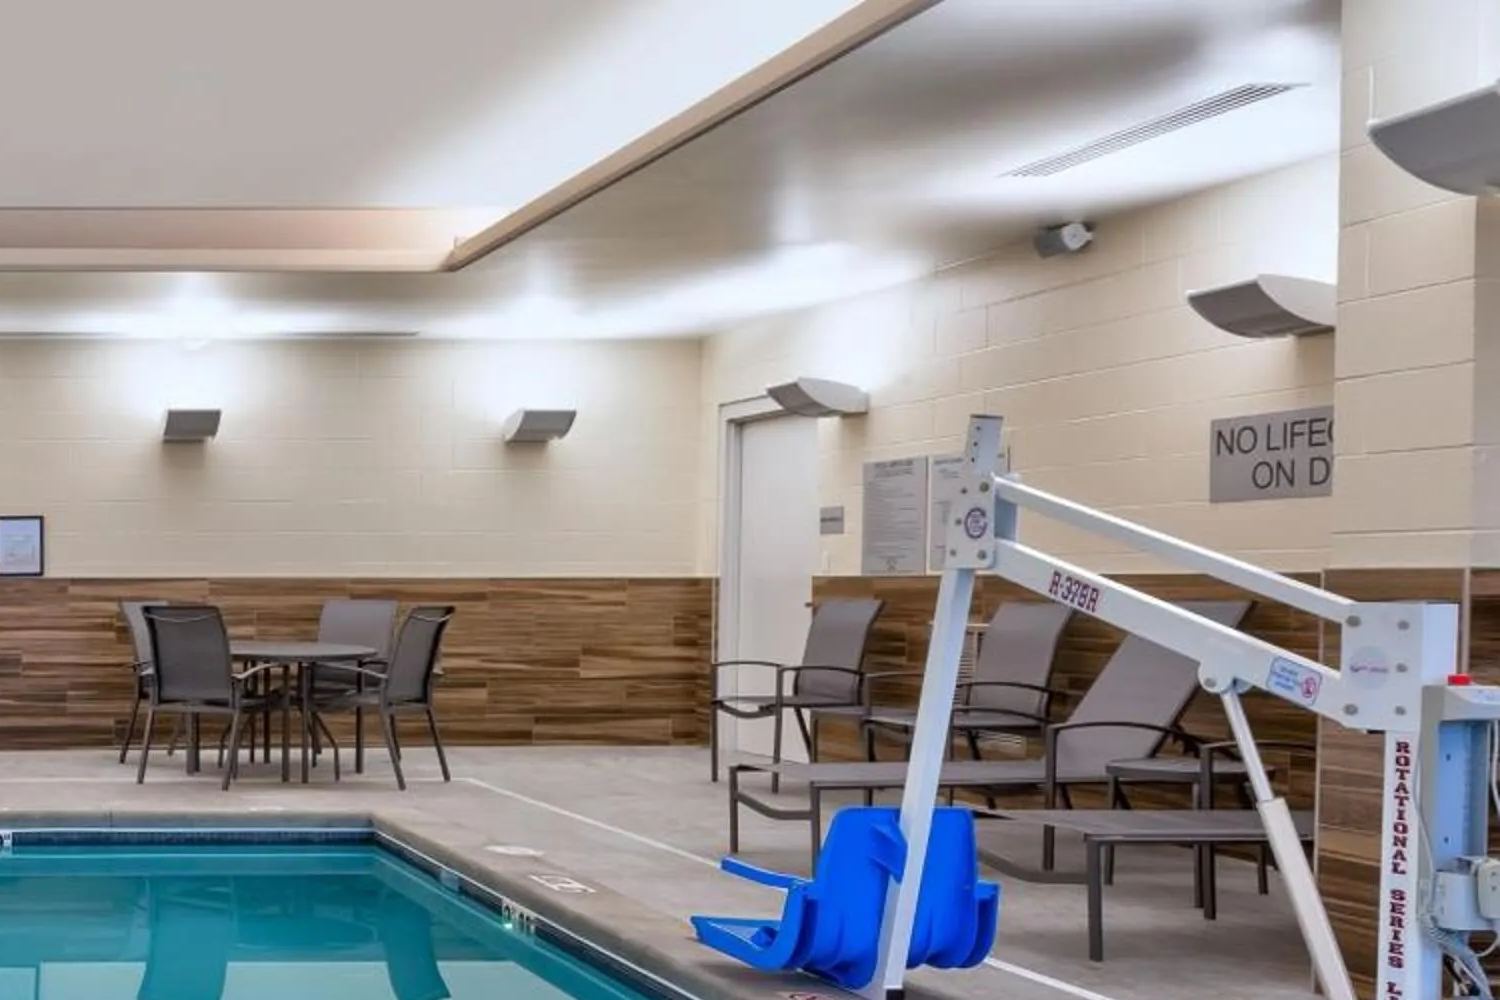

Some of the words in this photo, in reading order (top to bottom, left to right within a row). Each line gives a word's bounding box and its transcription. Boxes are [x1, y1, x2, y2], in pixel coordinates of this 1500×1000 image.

[1216, 425, 1258, 456] NO
[1266, 417, 1333, 452] LIFE
[1252, 460, 1295, 489] ON
[1391, 741, 1411, 875] ROTATIONAL
[1388, 889, 1406, 969] SERIES
